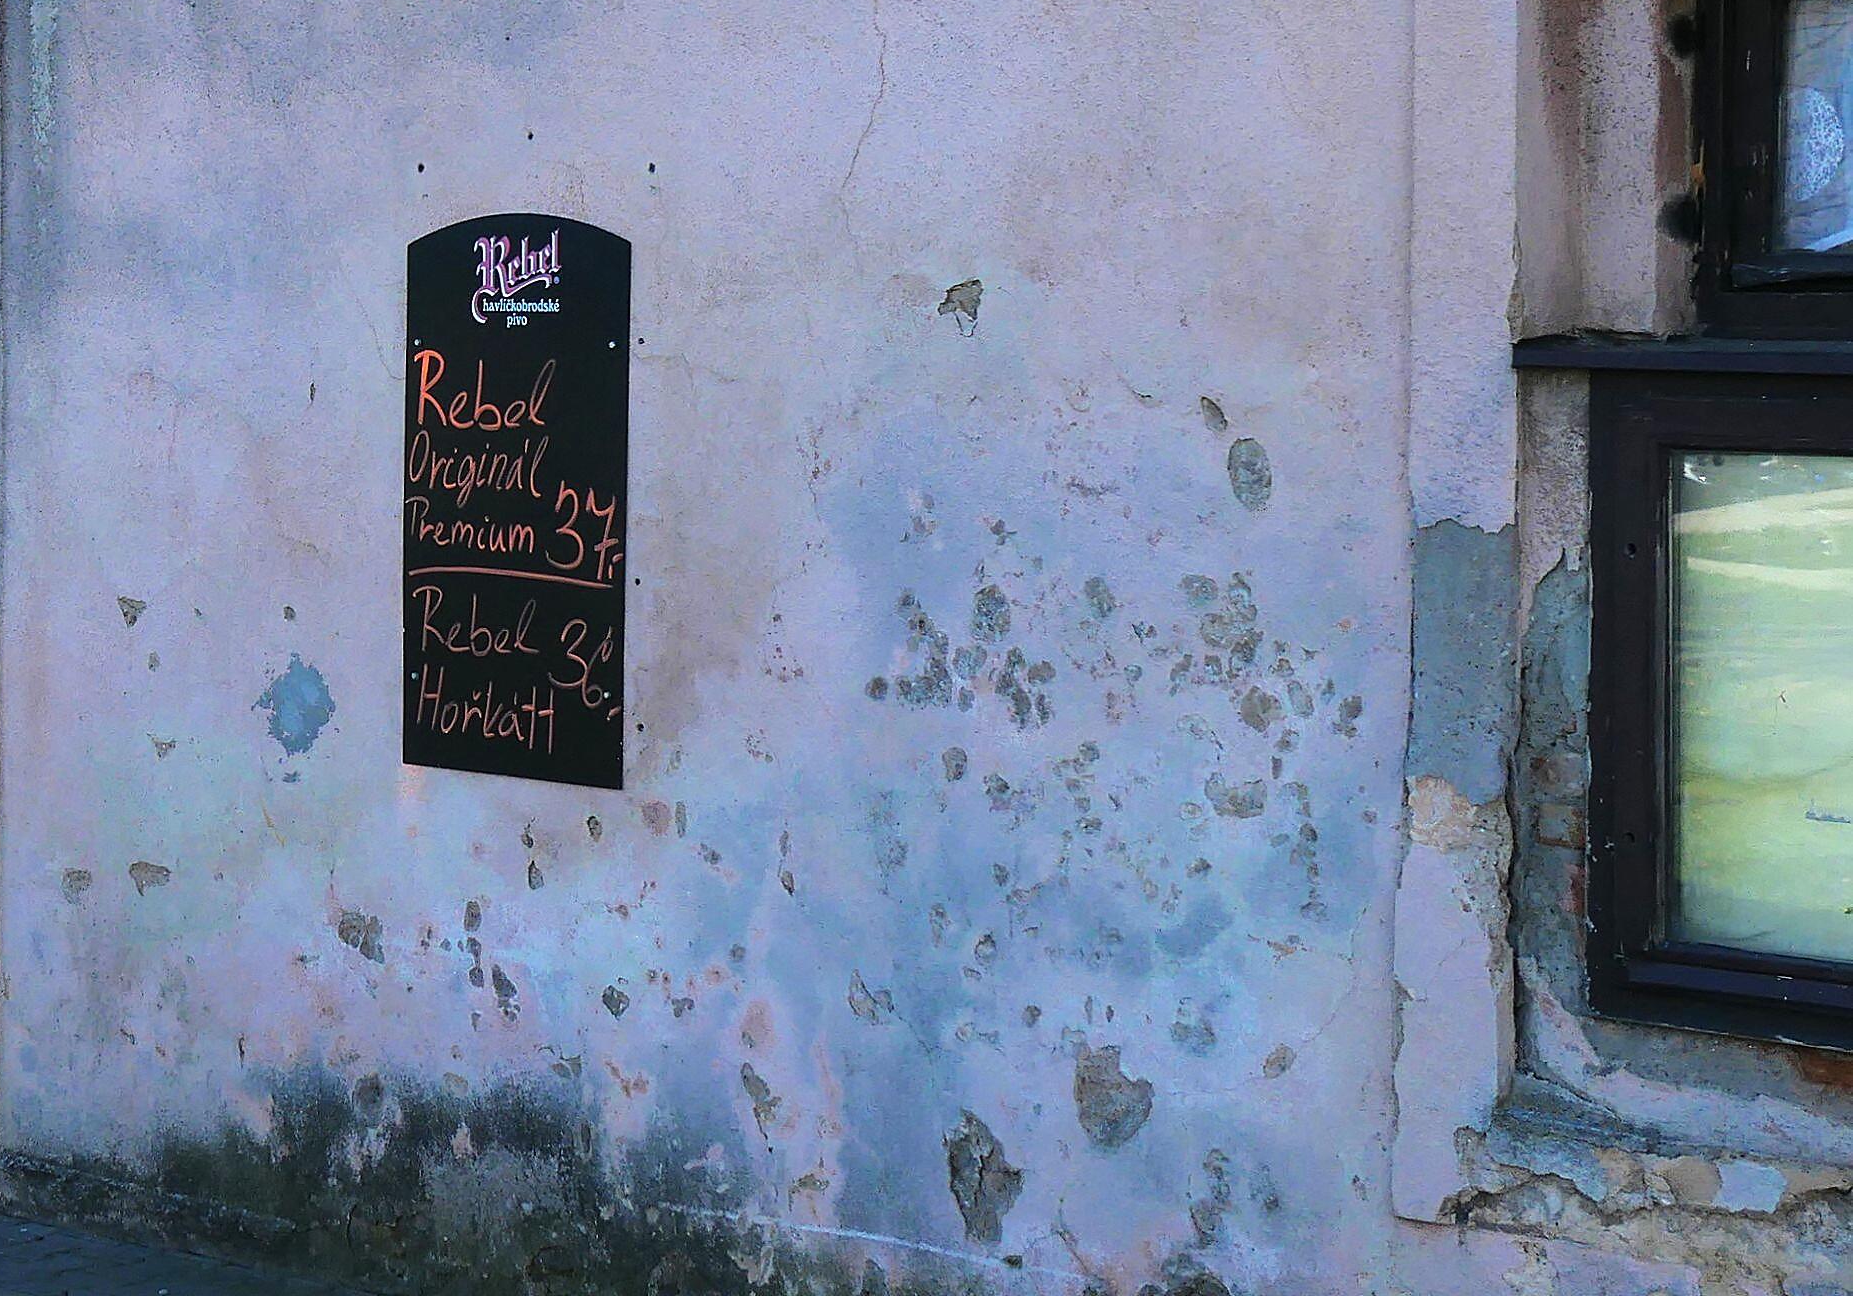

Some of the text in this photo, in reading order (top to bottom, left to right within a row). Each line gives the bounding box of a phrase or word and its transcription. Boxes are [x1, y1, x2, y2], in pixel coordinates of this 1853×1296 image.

[472, 227, 562, 323] Rebel
[482, 298, 560, 312] havlíčkobrodské
[506, 313, 528, 328] pivo
[413, 350, 556, 431] Rebel
[405, 495, 535, 554] Premium
[412, 585, 540, 656] Rebel
